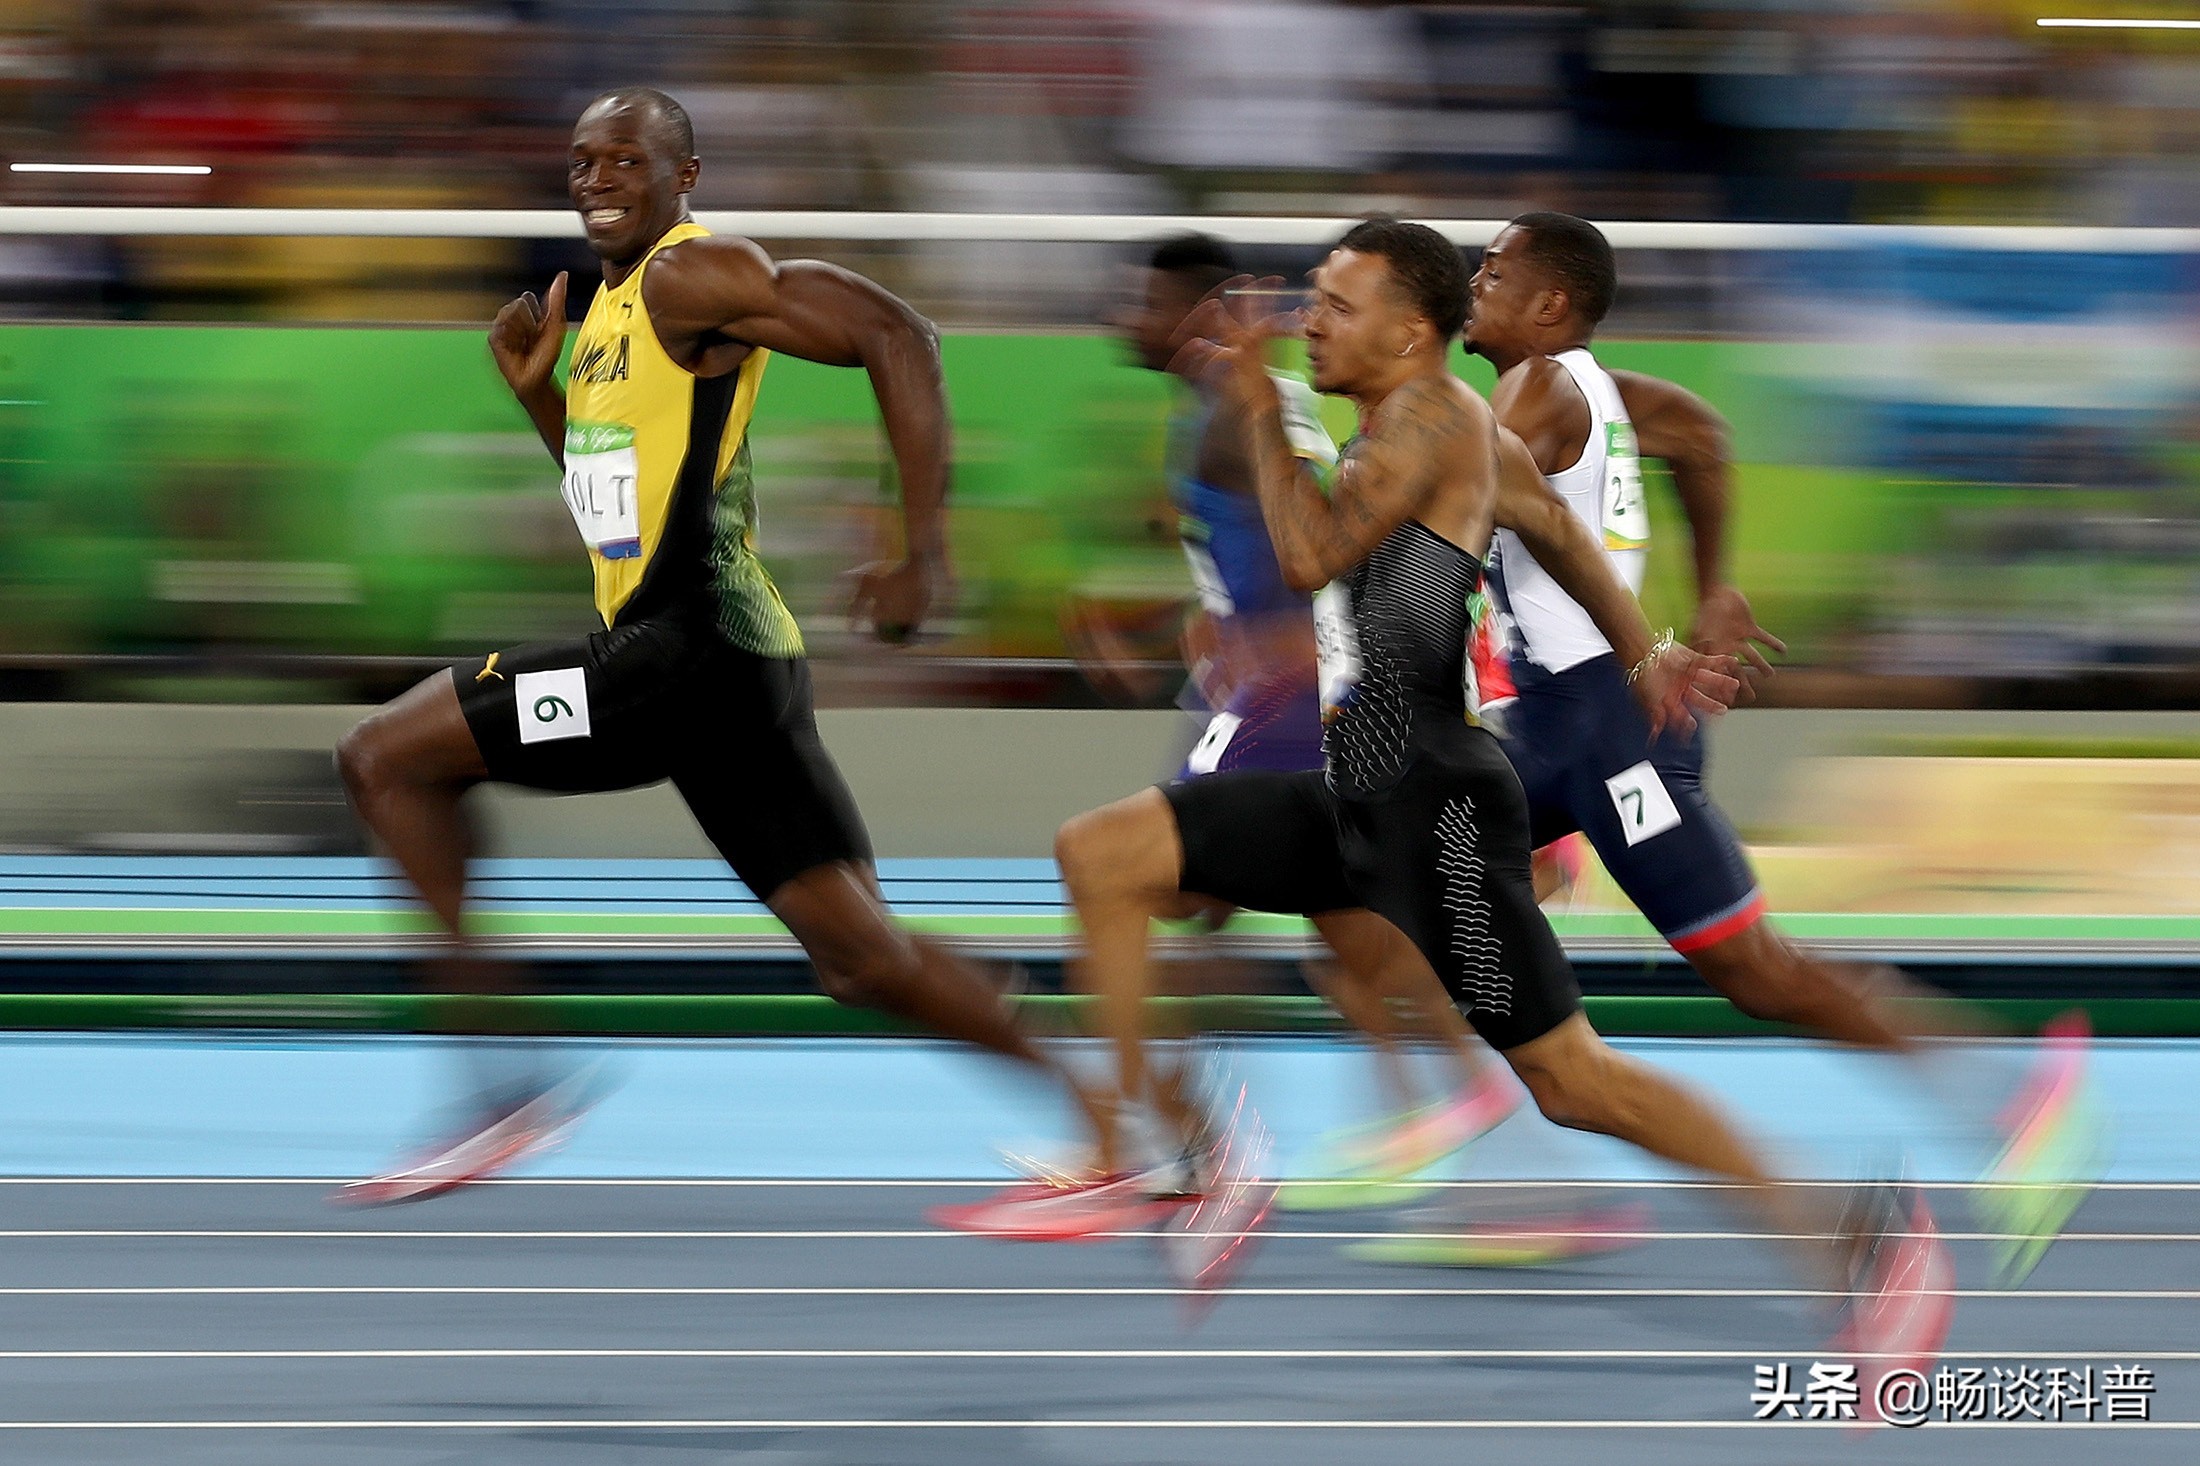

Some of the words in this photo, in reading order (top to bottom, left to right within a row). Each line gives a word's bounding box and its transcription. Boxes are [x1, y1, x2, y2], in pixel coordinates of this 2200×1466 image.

[563, 471, 634, 518] OLT
[534, 694, 574, 722] 6
[1620, 785, 1644, 826] 7
